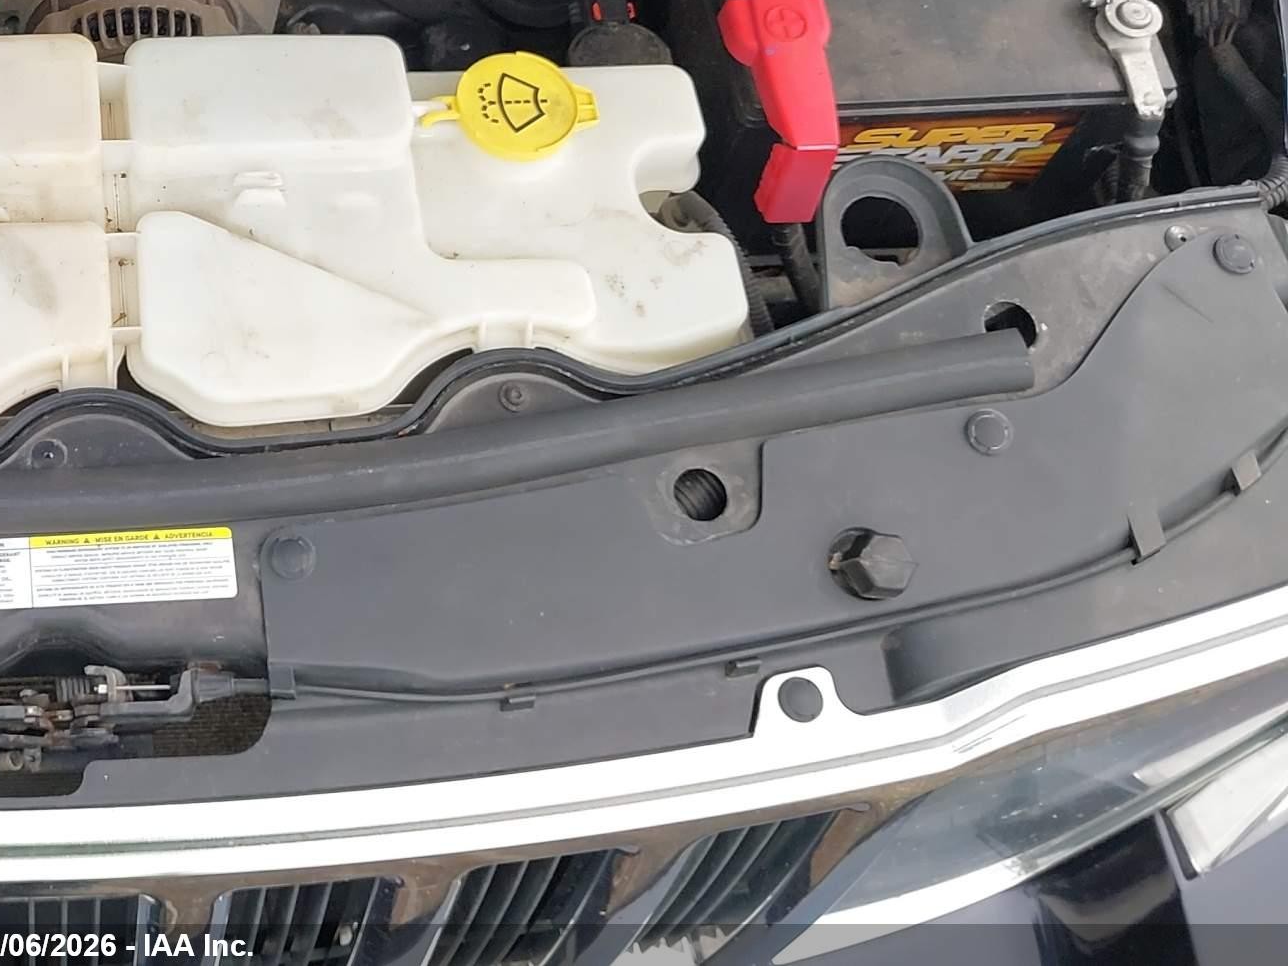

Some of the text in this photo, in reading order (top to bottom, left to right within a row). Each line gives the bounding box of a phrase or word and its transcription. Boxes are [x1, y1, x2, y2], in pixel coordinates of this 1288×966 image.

[845, 123, 1056, 150] SUPER
[45, 537, 80, 546] WARNING
[124, 534, 150, 542] GARDE
[165, 531, 214, 539] ADVERTENCIA
